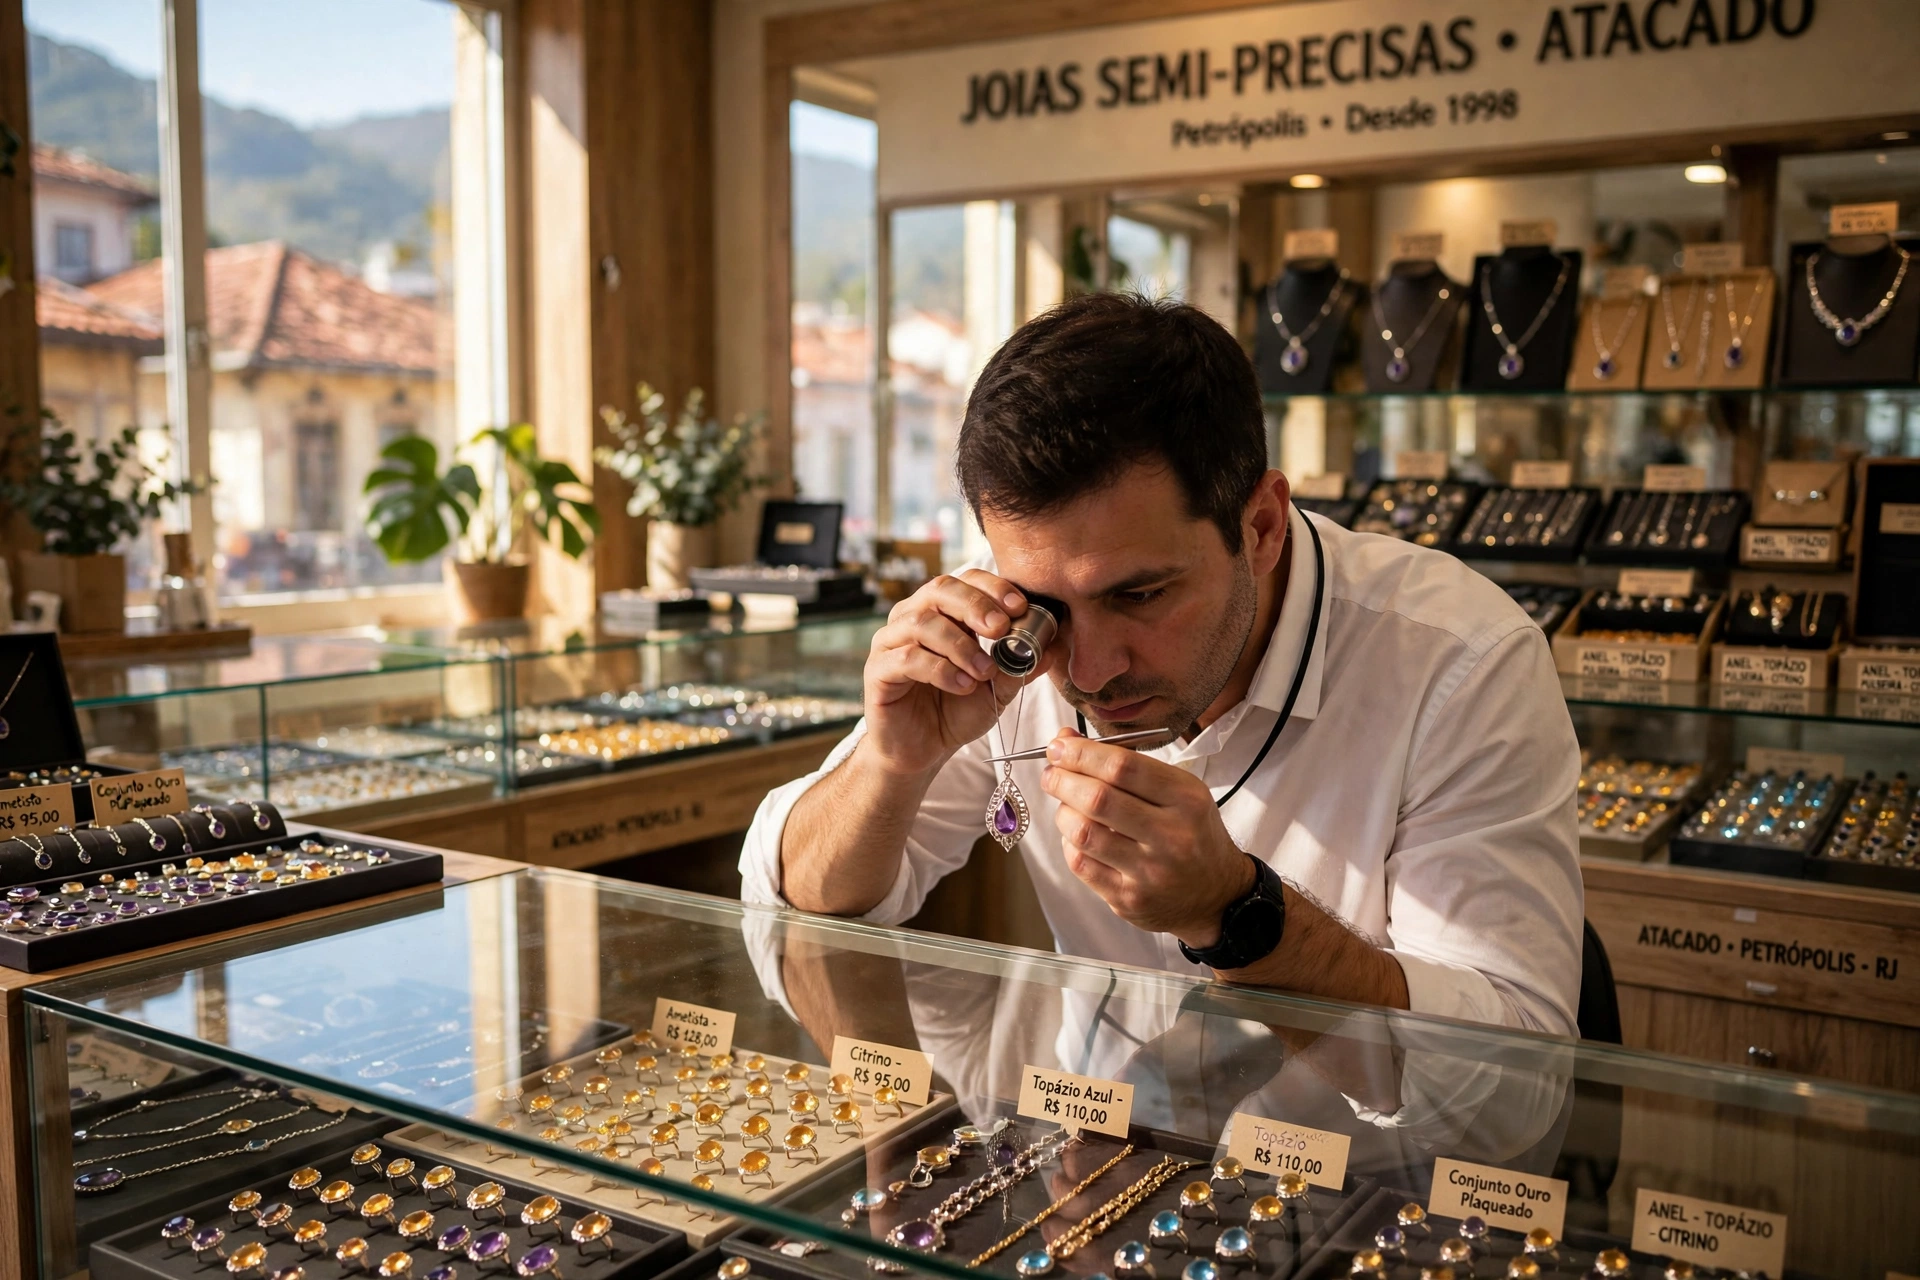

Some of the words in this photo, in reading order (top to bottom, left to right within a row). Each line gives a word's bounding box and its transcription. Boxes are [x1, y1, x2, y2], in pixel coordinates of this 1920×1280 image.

[961, 62, 1082, 125] JOIAS
[1097, 18, 1476, 107] SEMI-PRECISAS
[1537, 0, 1815, 62] ATACADO
[1172, 109, 1306, 149] Petrópolis
[1346, 97, 1435, 133] Desde
[1448, 88, 1518, 124] 1998
[1583, 651, 1609, 663] ANEL
[1621, 650, 1666, 666] TOPÁZIO
[1726, 657, 1752, 669] ANEL
[1763, 656, 1807, 673] TOPÁZIO
[1862, 665, 1890, 677] ANEL
[20, 810, 59, 826] 95,00
[1638, 924, 1721, 954] ATACADO
[1740, 939, 1855, 975] PETRÓPOLIS
[1875, 956, 1898, 980] RJ
[666, 1006, 708, 1026] Ametista
[666, 1024, 679, 1040] R$
[850, 1046, 892, 1067] Citrino
[853, 1067, 869, 1085] R$
[1033, 1074, 1080, 1097] Topázio
[1084, 1086, 1113, 1104] Azul
[1044, 1098, 1060, 1116] R$
[1065, 1103, 1107, 1125] 110,00
[1254, 1126, 1306, 1150] Topázio
[1254, 1147, 1271, 1166] R$
[1277, 1153, 1322, 1175] 110,00
[1449, 1169, 1511, 1195] Conjunto
[1515, 1182, 1551, 1202] Ouro
[1460, 1192, 1533, 1219] Plaqueado
[1648, 1200, 1688, 1223] ANEL
[1704, 1210, 1773, 1238] TOPÁZIO
